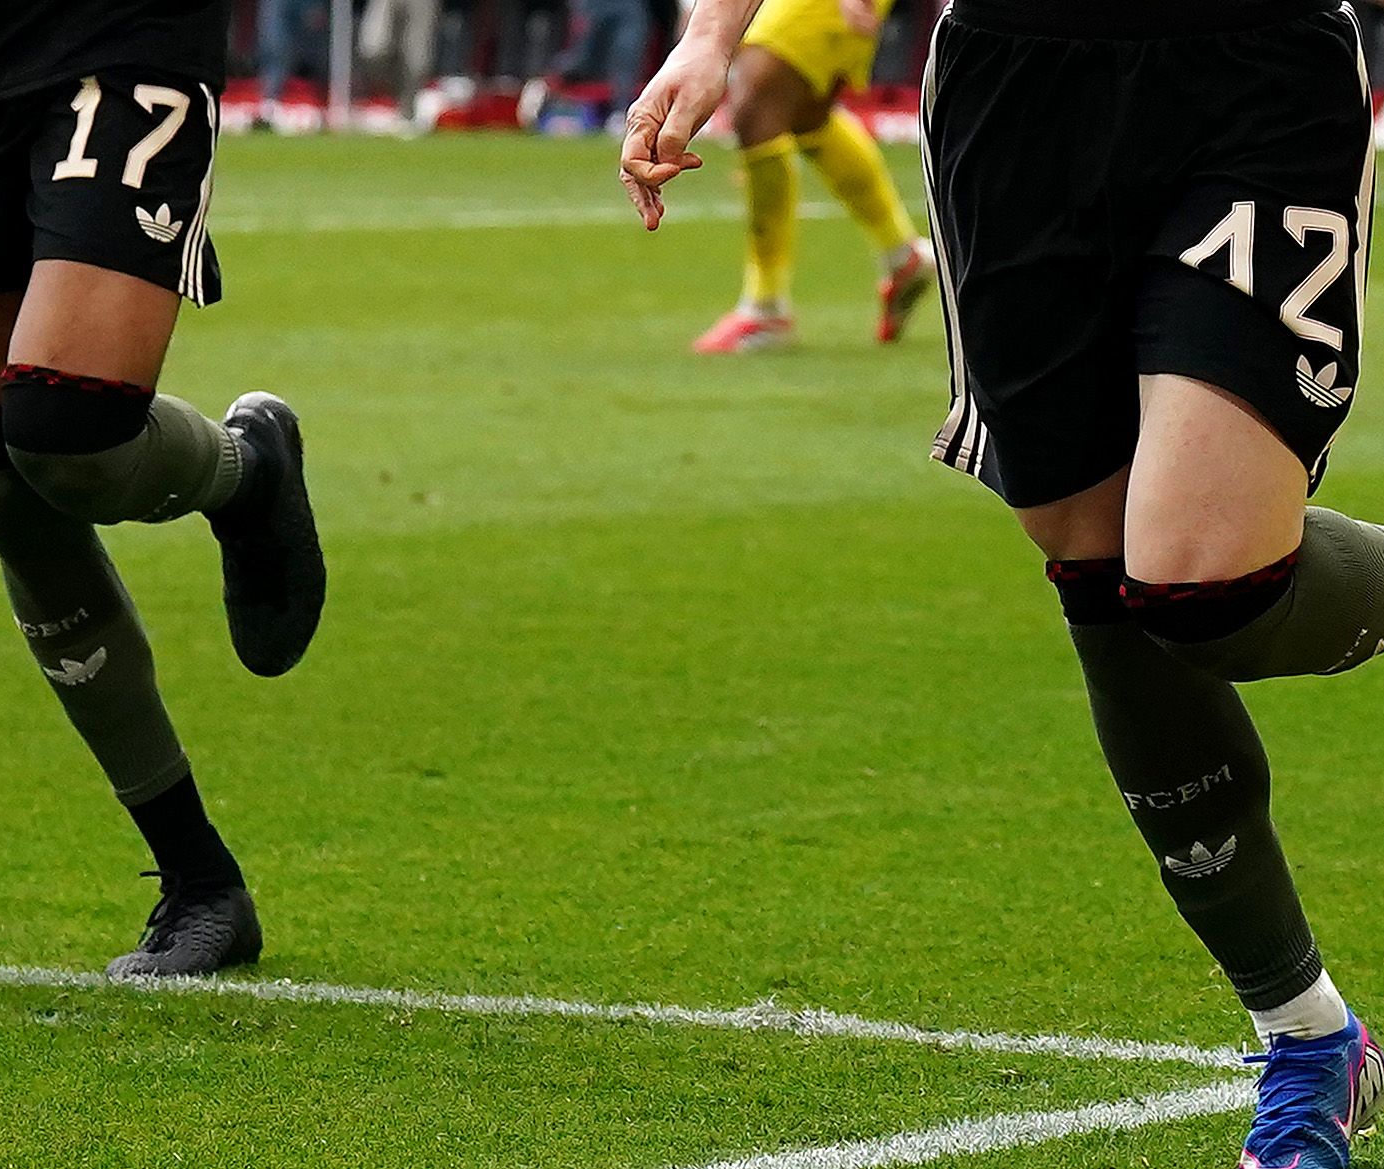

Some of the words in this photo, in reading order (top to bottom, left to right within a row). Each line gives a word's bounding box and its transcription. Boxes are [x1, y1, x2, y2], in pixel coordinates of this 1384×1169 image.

[51, 74, 190, 188] 17
[1179, 201, 1348, 351] 12
[1123, 763, 1233, 810] FCBM
